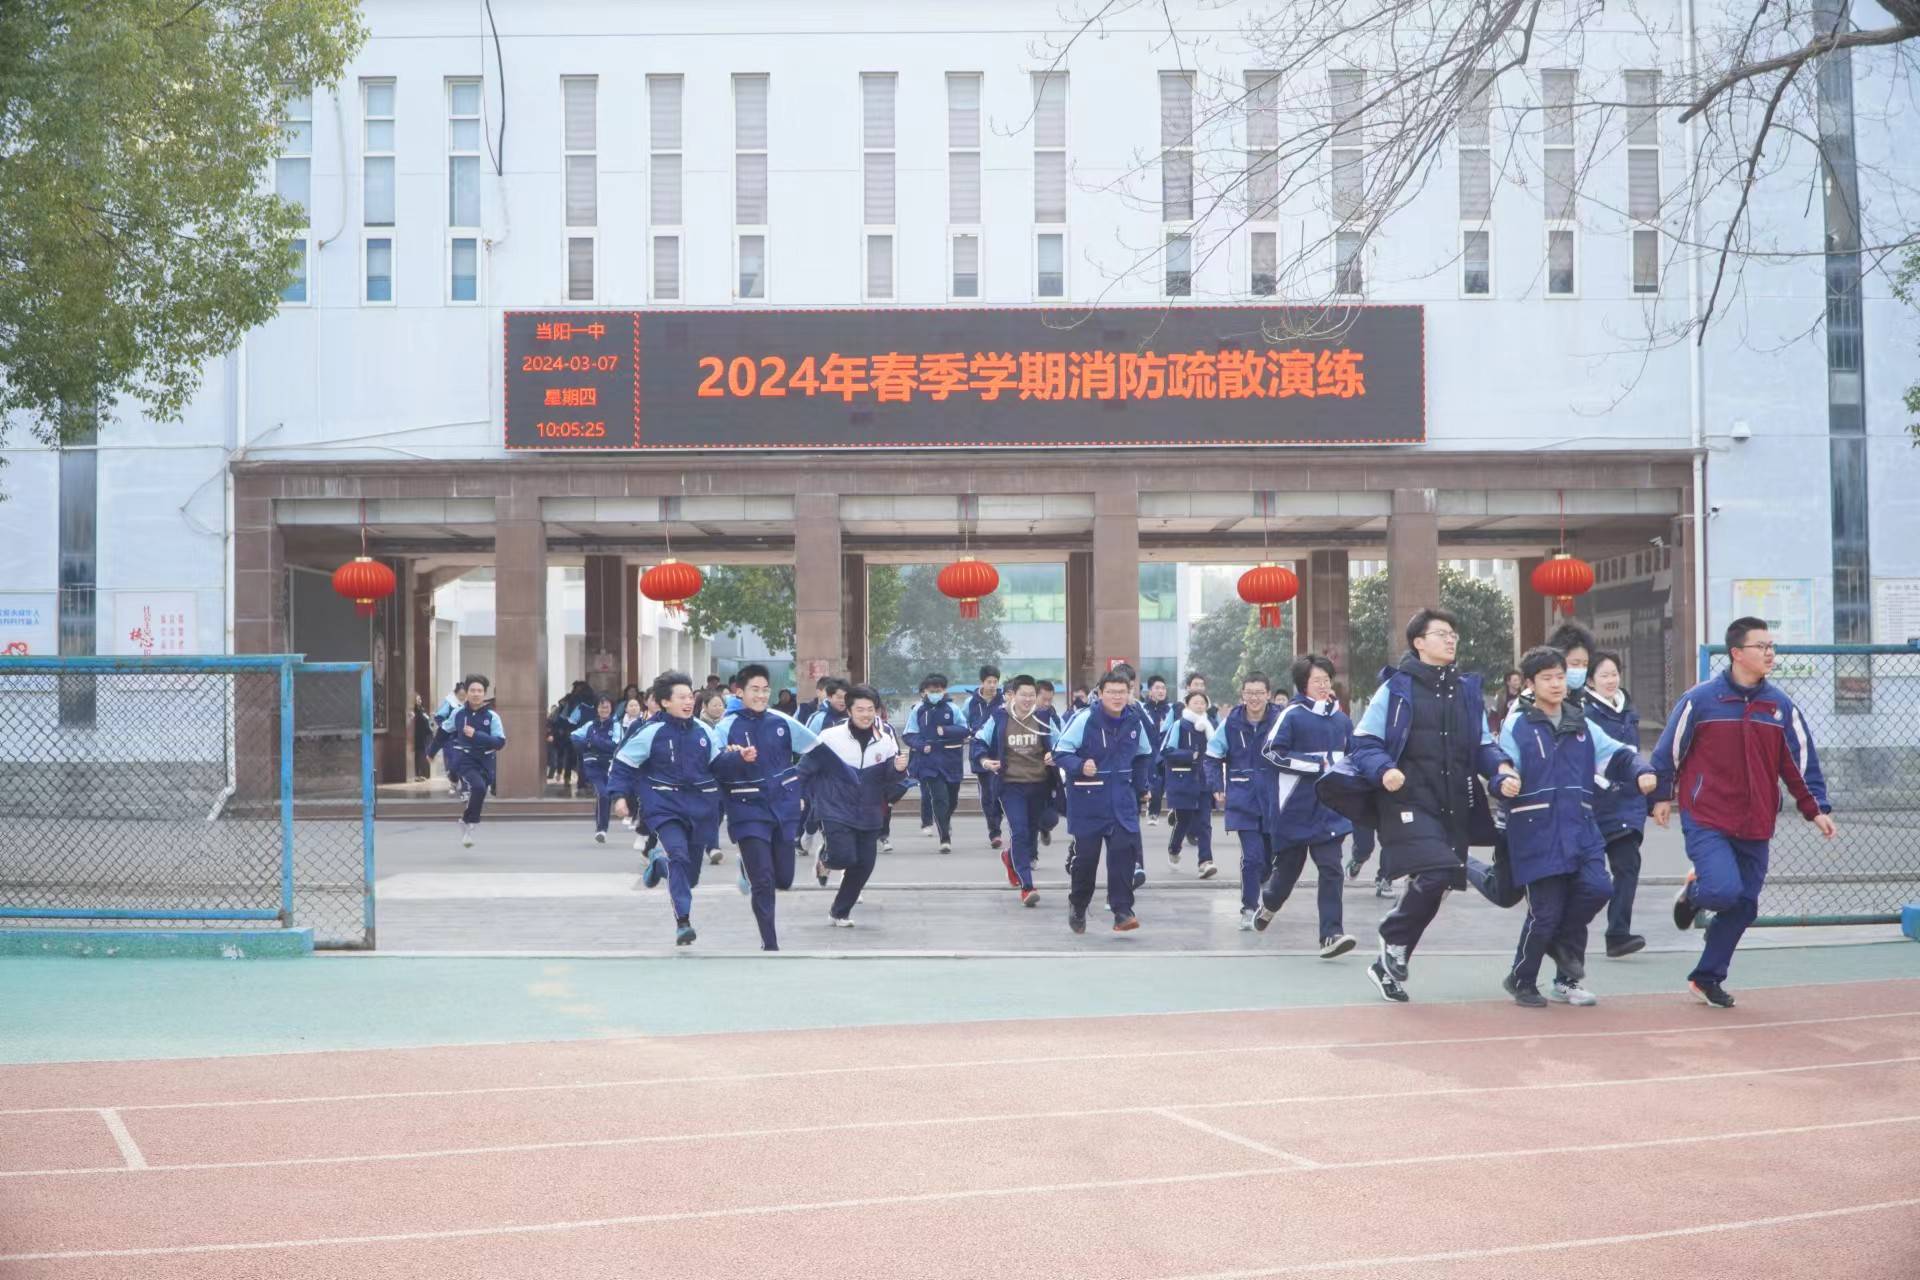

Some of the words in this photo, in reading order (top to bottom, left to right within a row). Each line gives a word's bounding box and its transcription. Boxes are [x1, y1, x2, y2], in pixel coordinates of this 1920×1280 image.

[536, 322, 605, 341] 当阳一中
[522, 355, 618, 372] 2024-03-07
[697, 349, 1366, 402] 2024年春季学期消防疏散演练
[543, 387, 597, 406] 星期四
[536, 421, 606, 438] 10:05:25
